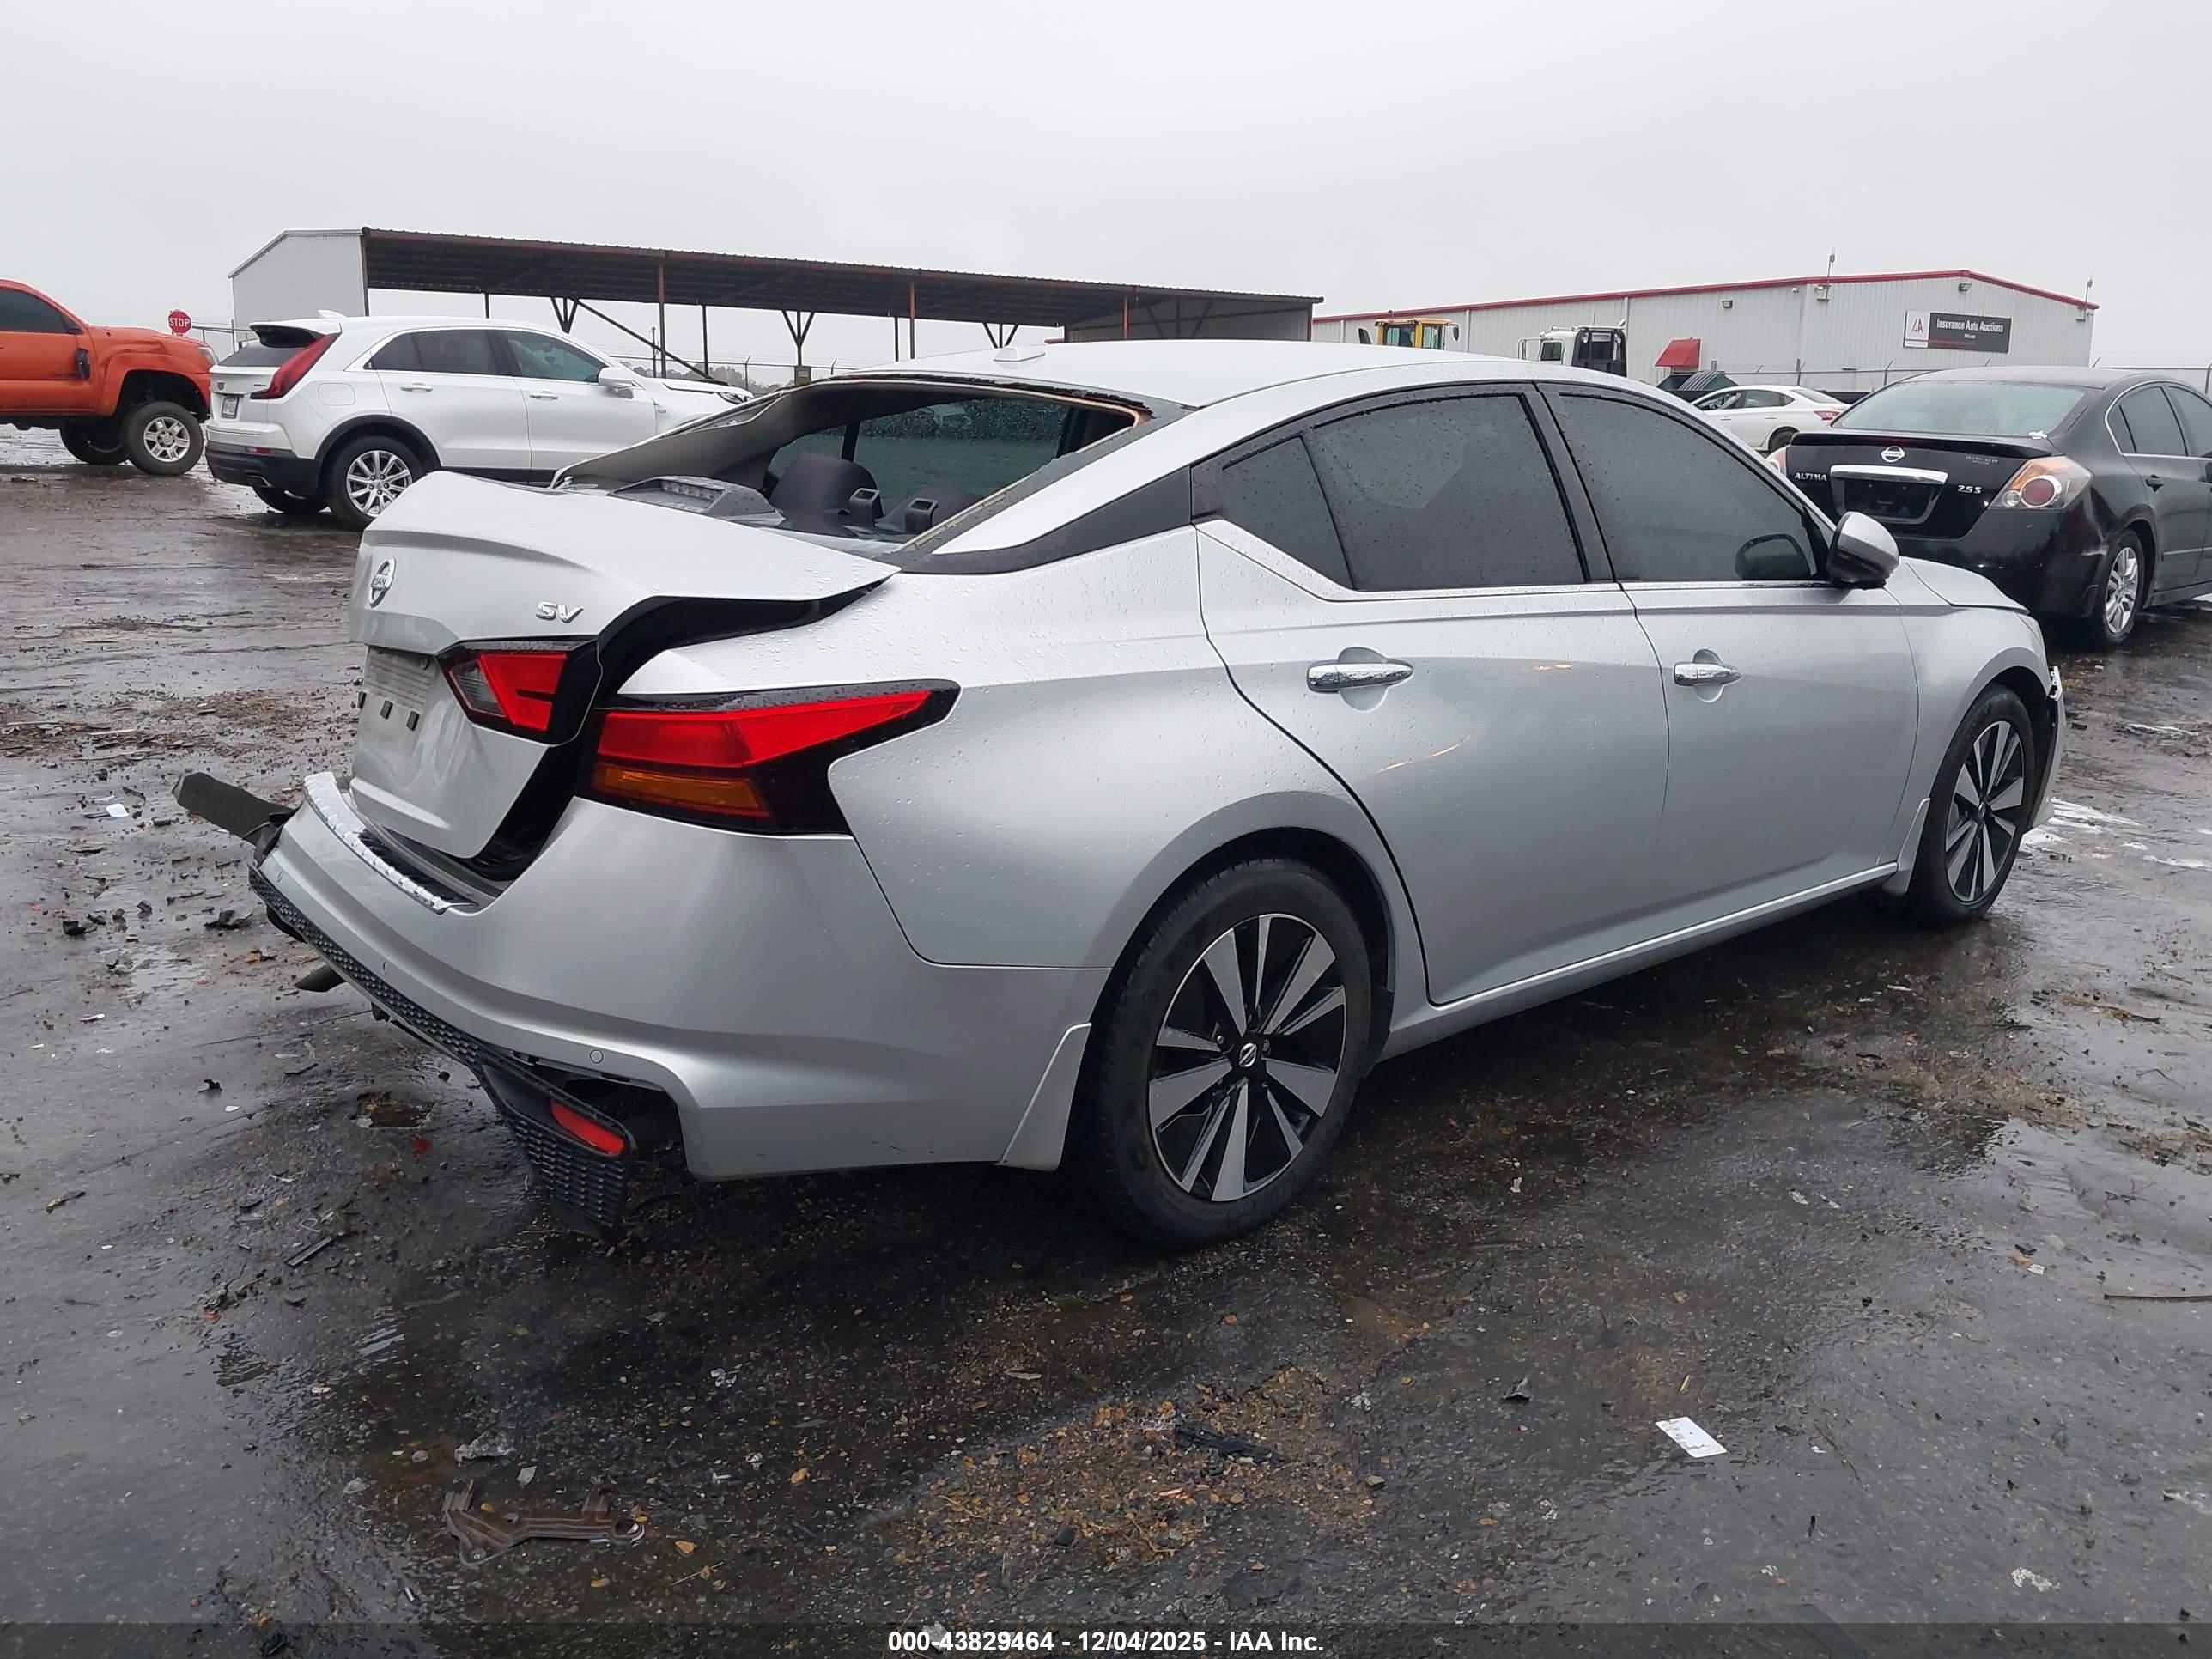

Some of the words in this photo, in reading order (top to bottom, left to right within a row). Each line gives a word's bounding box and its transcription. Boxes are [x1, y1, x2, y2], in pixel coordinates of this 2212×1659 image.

[169, 317, 191, 328] STOP
[1936, 317, 1966, 331] Insurance
[1965, 319, 1979, 331] Auto
[1979, 320, 2004, 333] Auctions
[1794, 472, 1827, 482] ALTIMA
[535, 601, 585, 624] SV
